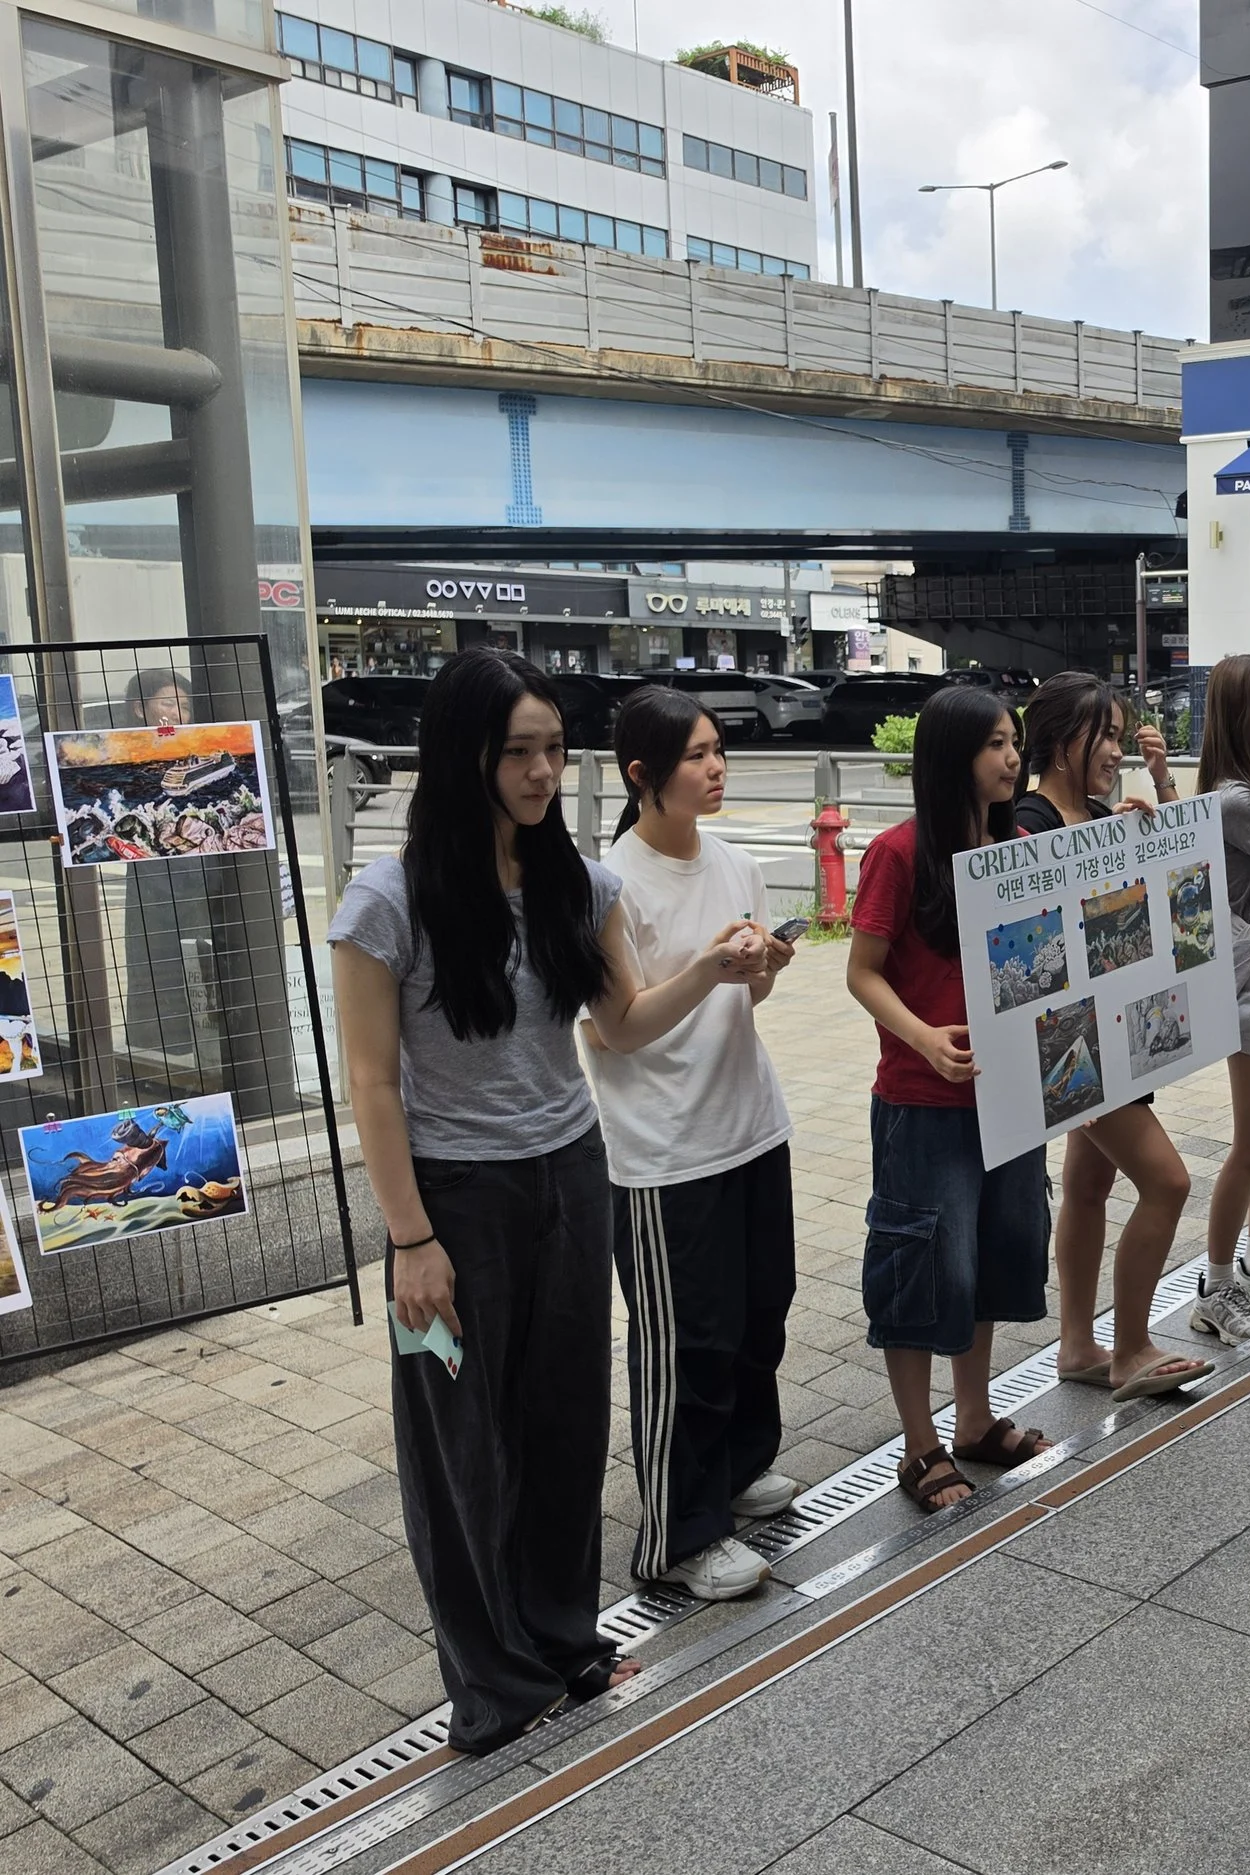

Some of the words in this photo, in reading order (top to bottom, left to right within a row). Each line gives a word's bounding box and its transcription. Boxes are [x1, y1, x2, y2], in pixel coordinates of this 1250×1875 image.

[335, 607, 353, 615] LUMI
[378, 608, 406, 617] OPTICAL
[968, 839, 1040, 880] GREEN
[1051, 819, 1126, 859] CANVAS
[1138, 797, 1213, 837] SOCIETY
[997, 881, 1025, 902] 어떤
[1028, 866, 1067, 894] 작품이
[1076, 859, 1099, 881] 가장
[1102, 851, 1126, 875] 인상
